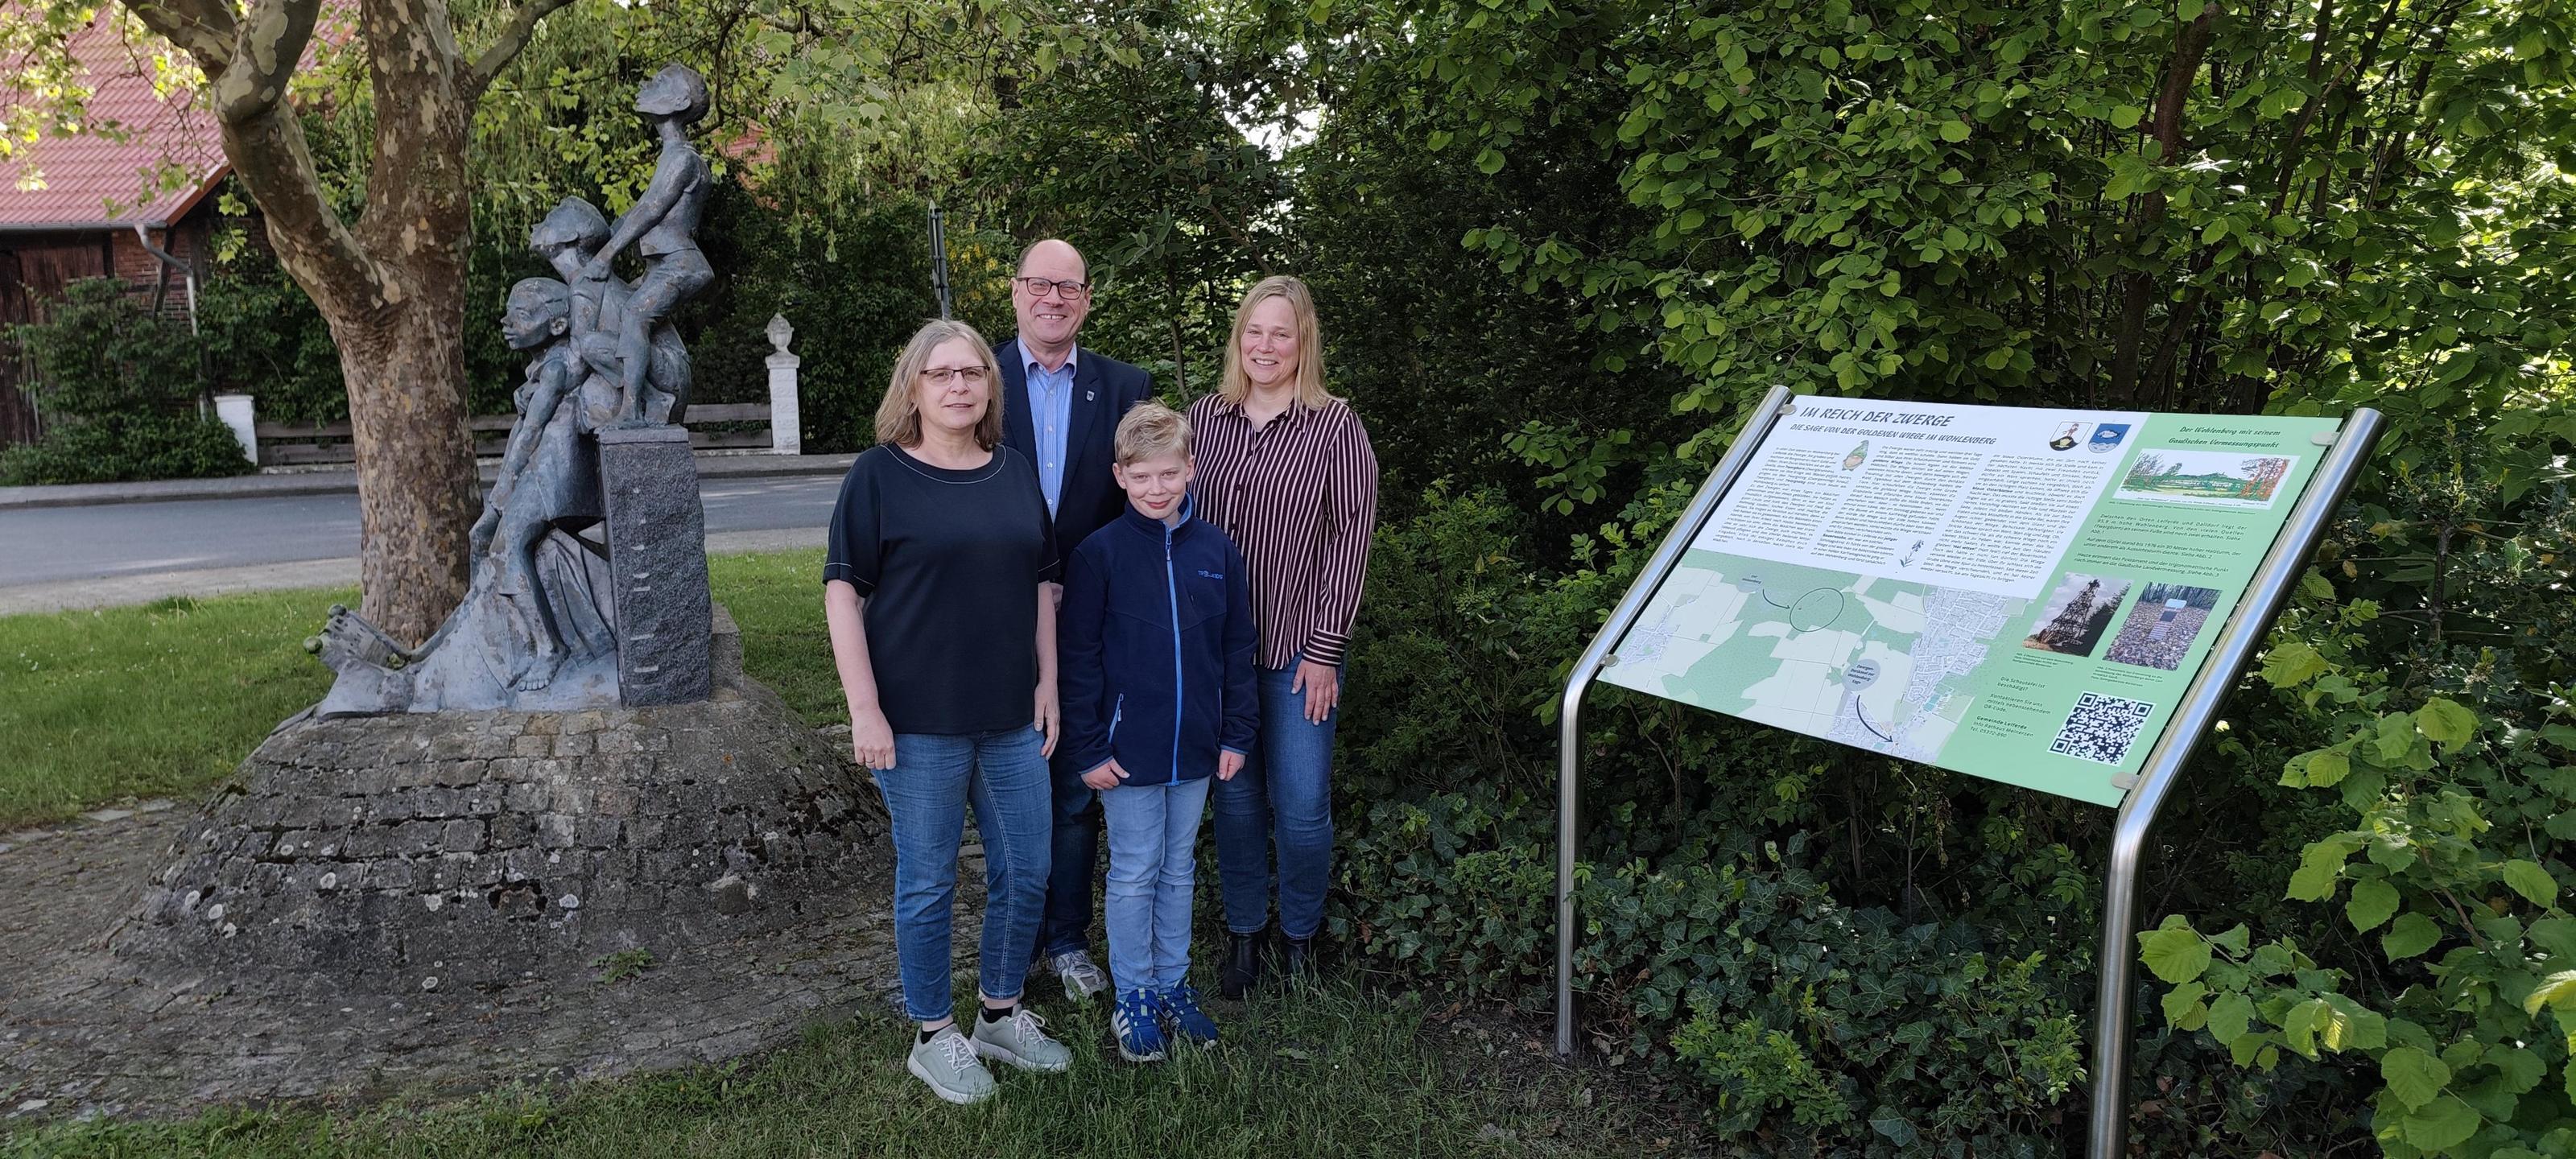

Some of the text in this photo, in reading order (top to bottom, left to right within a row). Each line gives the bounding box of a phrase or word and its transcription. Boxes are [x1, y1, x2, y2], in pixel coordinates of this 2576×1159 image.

[1799, 406, 1953, 427] IM REICH DER ZWERGE
[1803, 424, 1824, 432] SAGE
[1823, 426, 1842, 434] VON
[1857, 428, 1899, 438] GOLDENEN
[1898, 431, 1926, 440] WIEGE
[1938, 435, 1996, 444] WOHLENBERG
[2194, 427, 2237, 435] Wohlenberg
[2210, 439, 2279, 448] Vermessungspunkt
